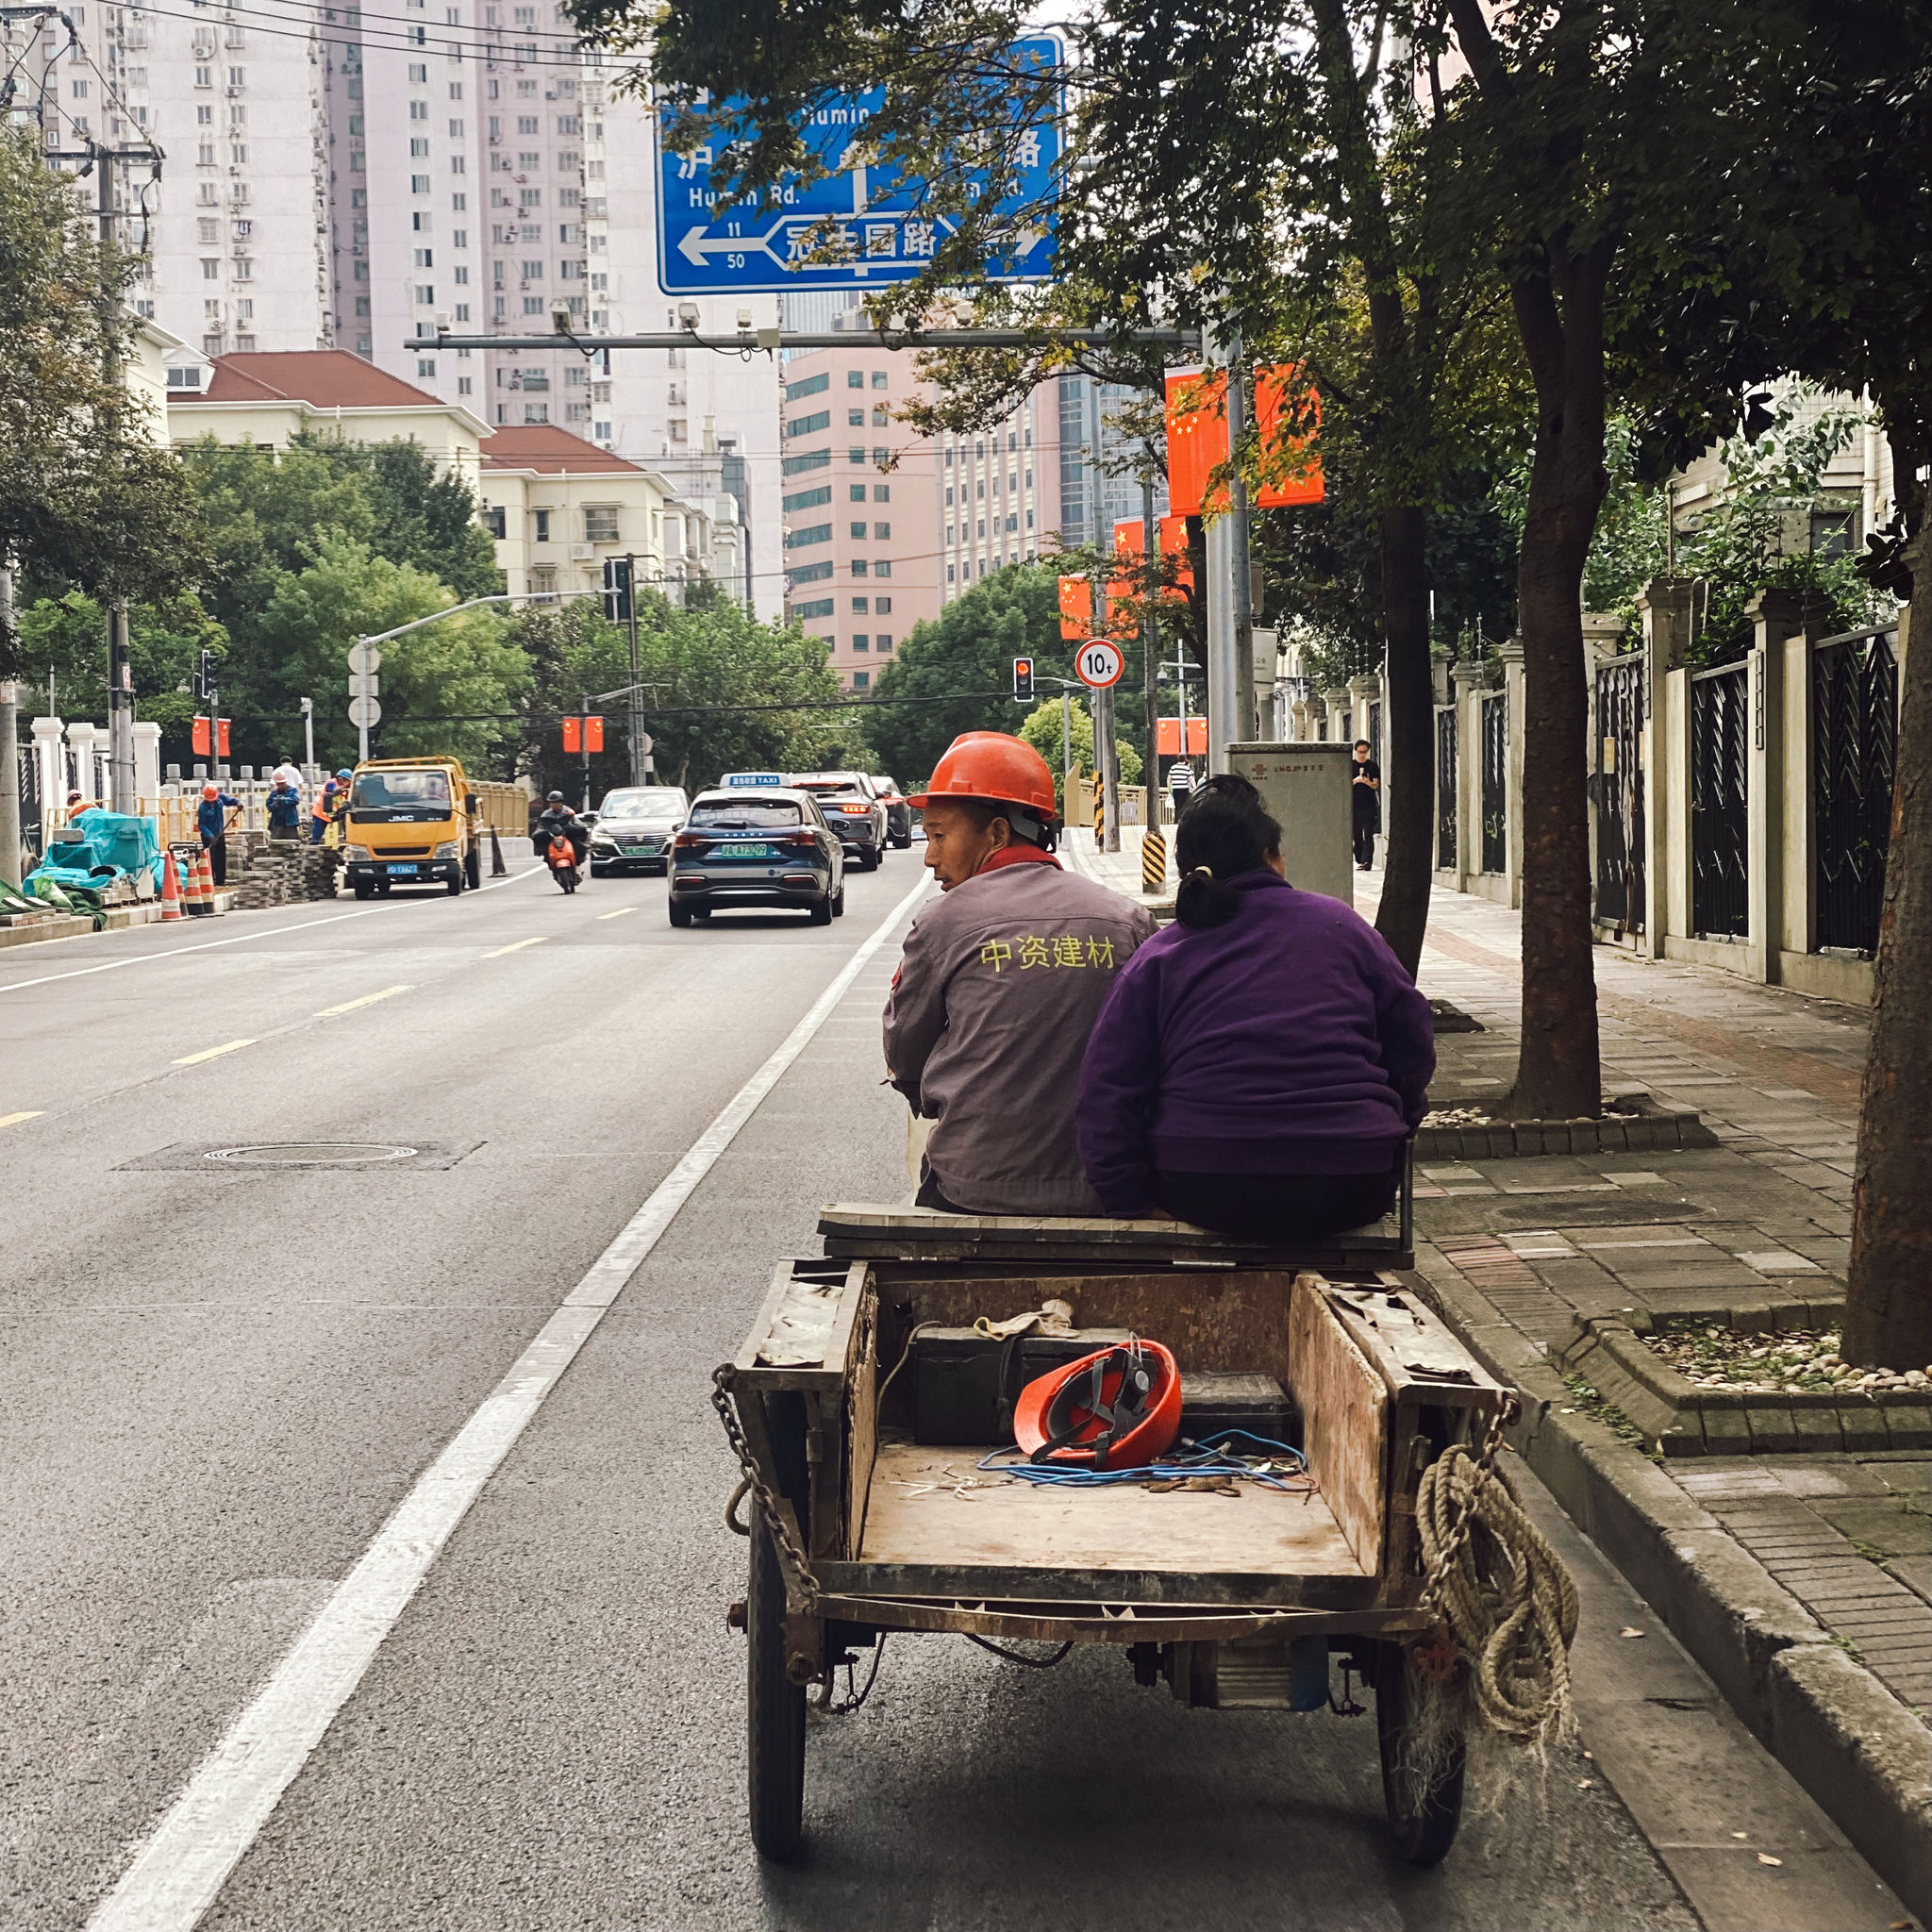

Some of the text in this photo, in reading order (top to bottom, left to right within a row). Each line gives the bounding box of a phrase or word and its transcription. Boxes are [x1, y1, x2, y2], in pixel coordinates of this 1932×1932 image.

[770, 184, 800, 205] Rd.
[727, 222, 741, 237] 11
[727, 253, 745, 269] 50
[1087, 653, 1113, 675] 10t
[981, 935, 1114, 973] 中资建材
